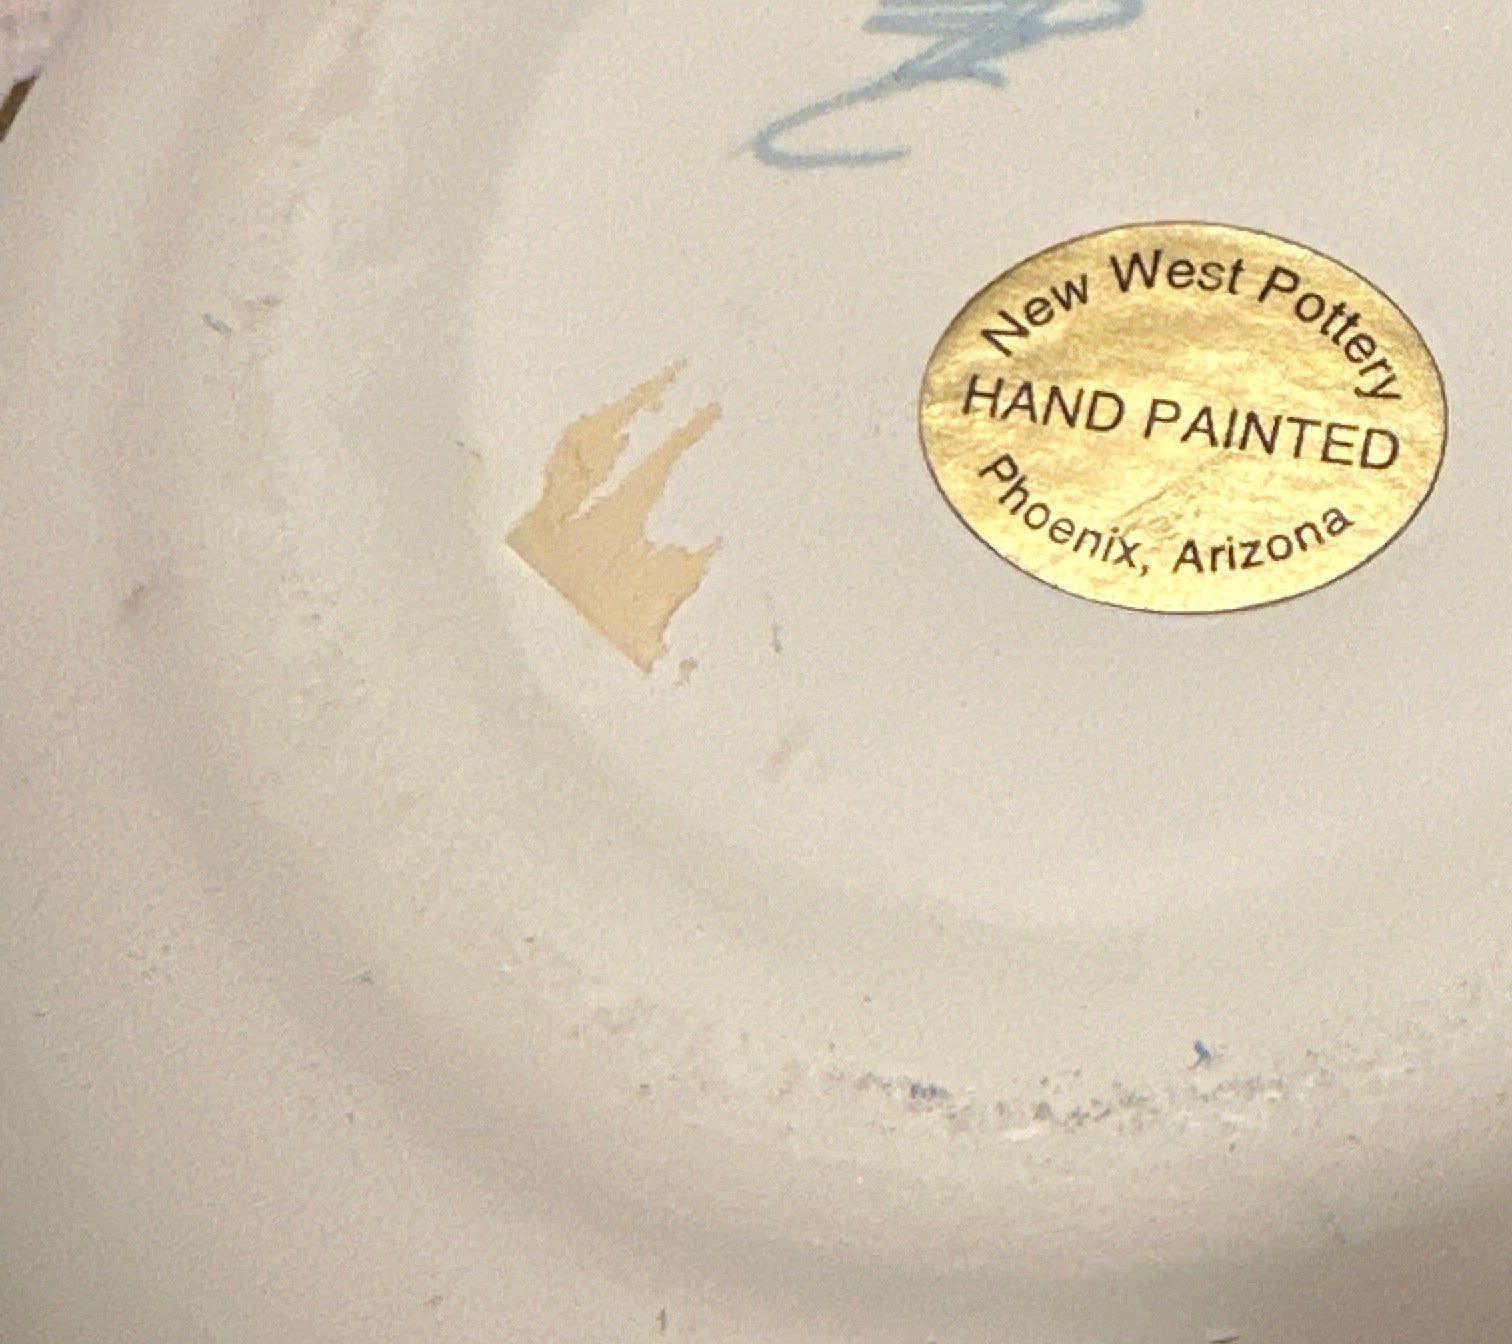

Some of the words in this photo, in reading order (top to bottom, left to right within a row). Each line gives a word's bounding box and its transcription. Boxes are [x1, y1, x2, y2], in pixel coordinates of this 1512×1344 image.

[980, 272, 1090, 357] New
[1109, 248, 1246, 297] West
[1257, 264, 1402, 406] Pottery
[961, 373, 1126, 433] HAND
[1143, 397, 1401, 471] PAINTED
[977, 452, 1152, 577] Phoenix,
[1171, 504, 1355, 575] Arizona
